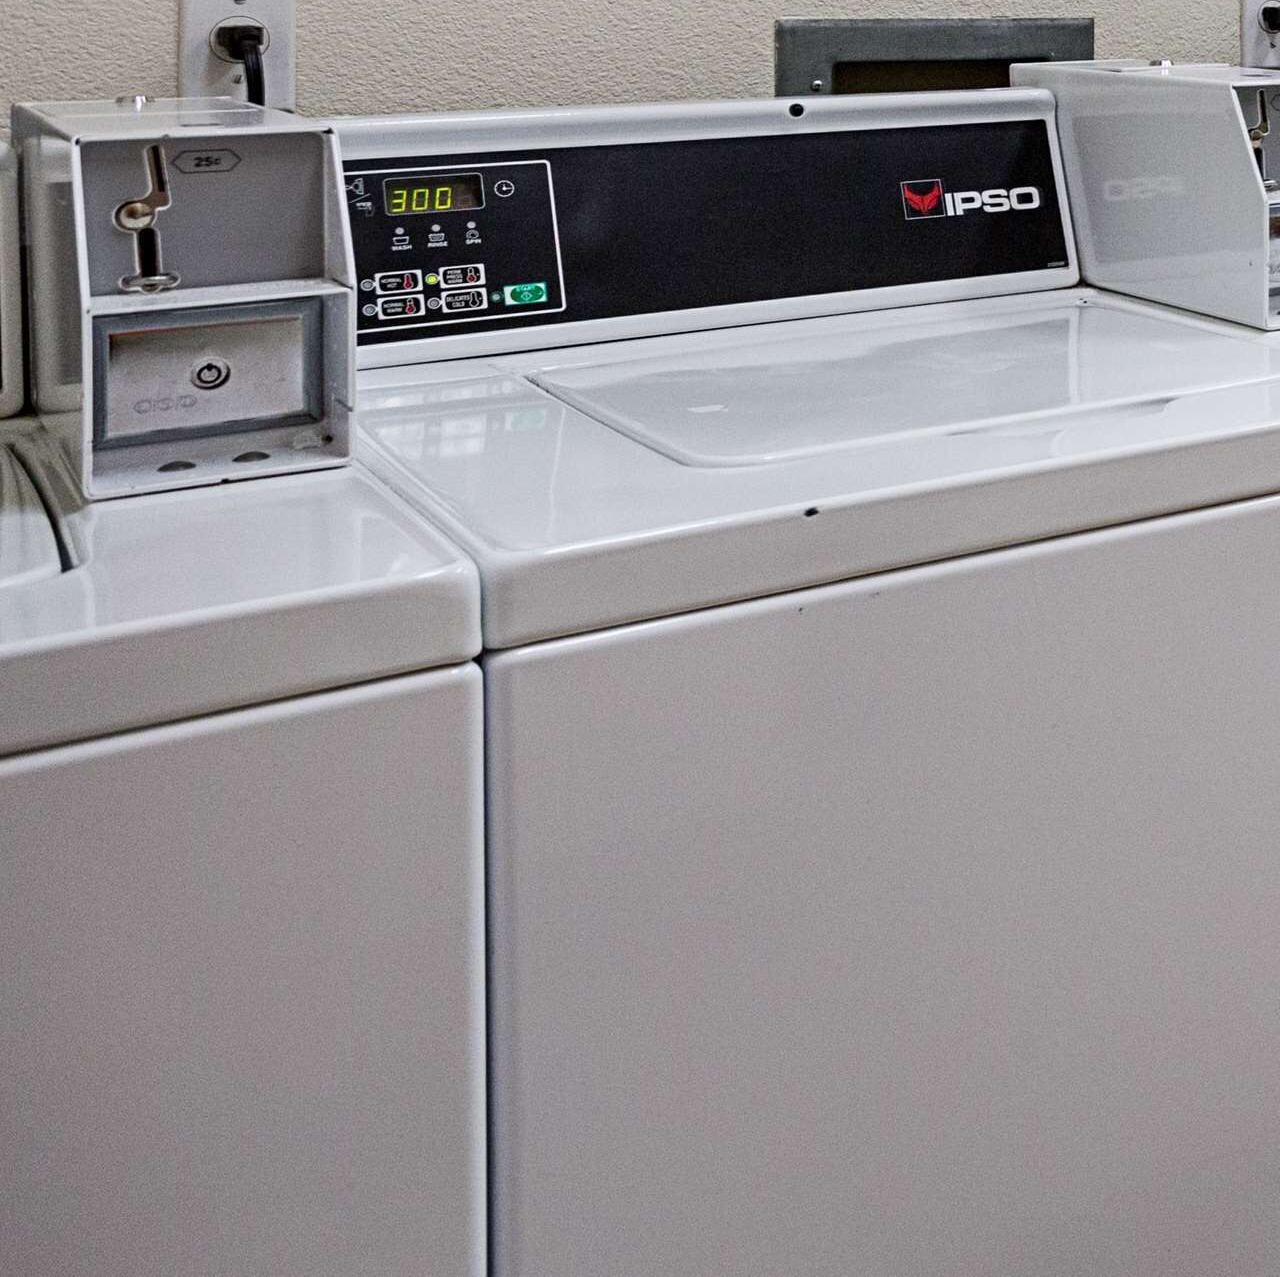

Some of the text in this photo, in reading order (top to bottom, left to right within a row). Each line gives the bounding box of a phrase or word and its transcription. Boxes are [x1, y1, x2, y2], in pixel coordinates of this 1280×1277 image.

[391, 187, 452, 213] 300
[944, 185, 1041, 217] IPSO
[391, 244, 413, 252] WASH
